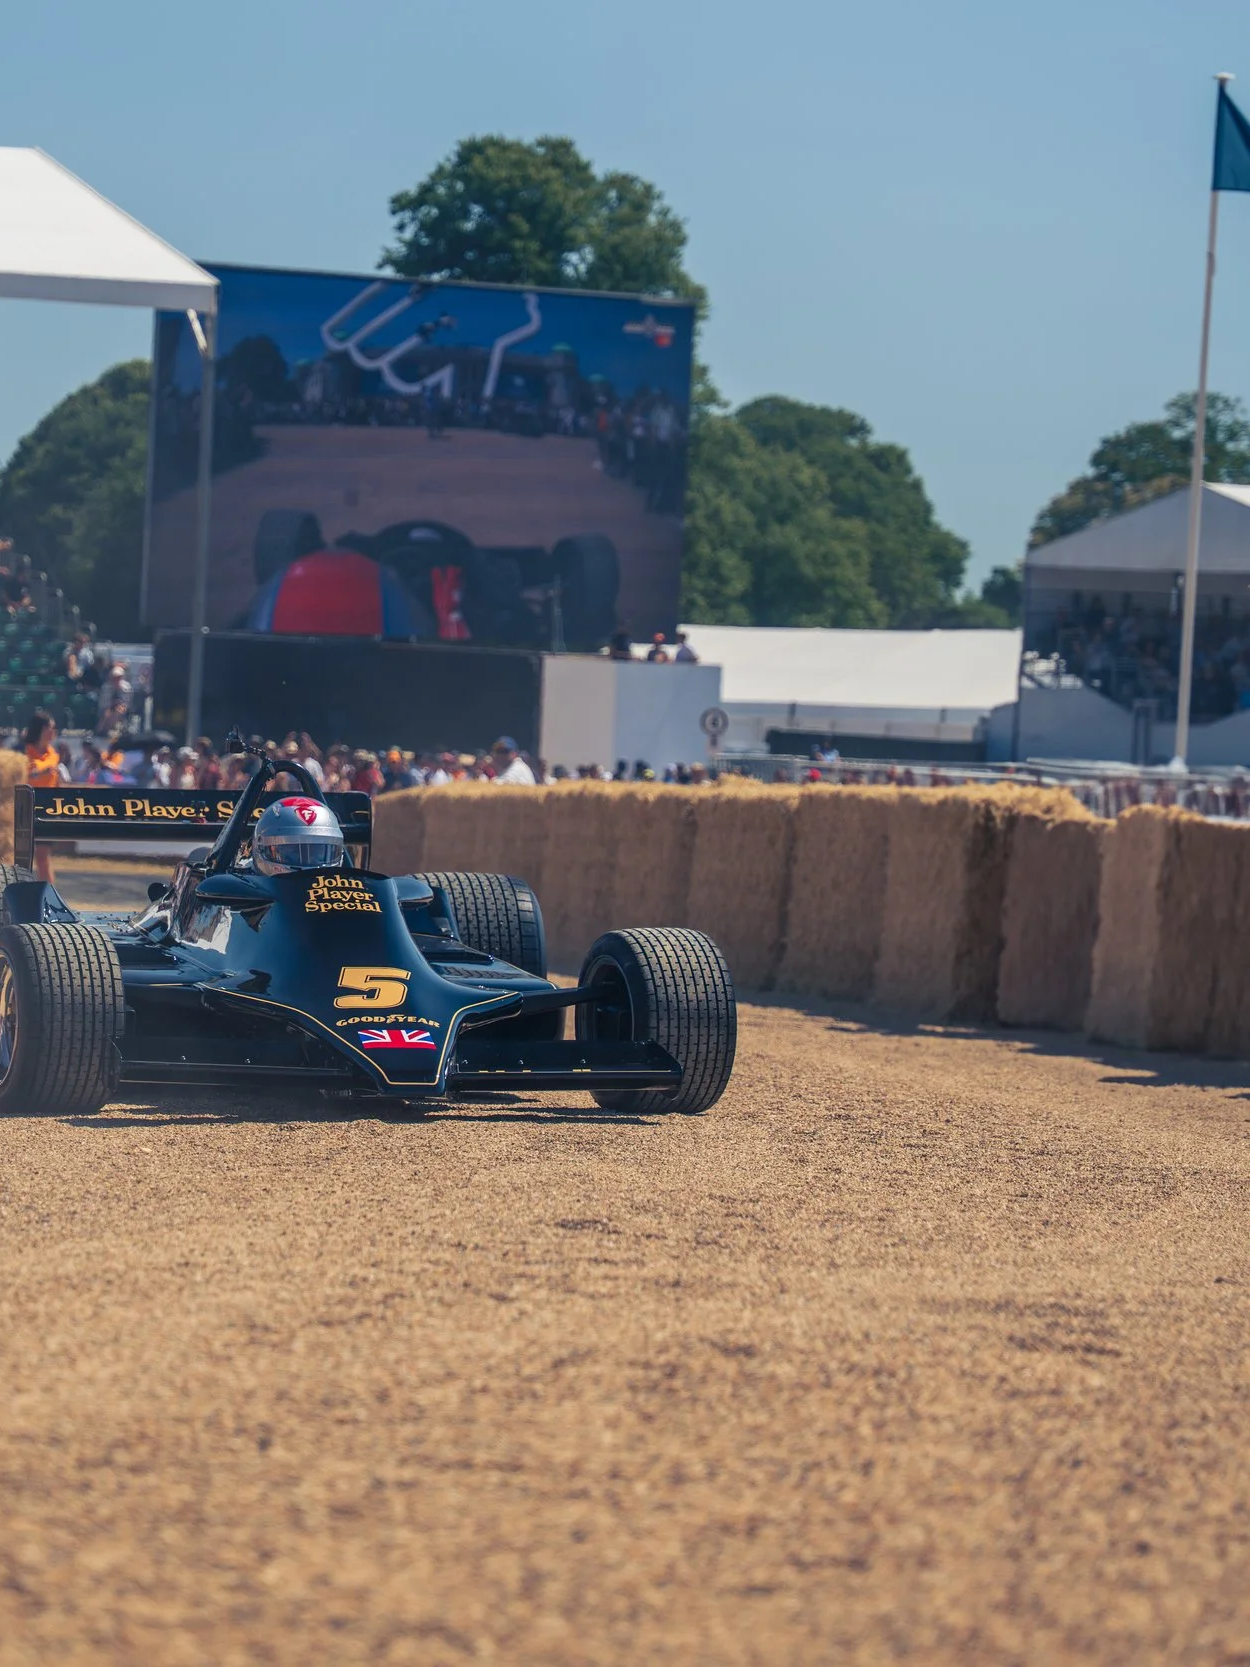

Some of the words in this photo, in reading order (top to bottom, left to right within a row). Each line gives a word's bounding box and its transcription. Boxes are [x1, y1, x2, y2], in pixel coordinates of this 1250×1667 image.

[45, 798, 117, 817] John
[311, 874, 365, 890] John
[307, 887, 374, 902] Player
[304, 899, 383, 913] Special
[333, 966, 411, 1009] 5
[335, 1014, 441, 1028] GOODYEAR
